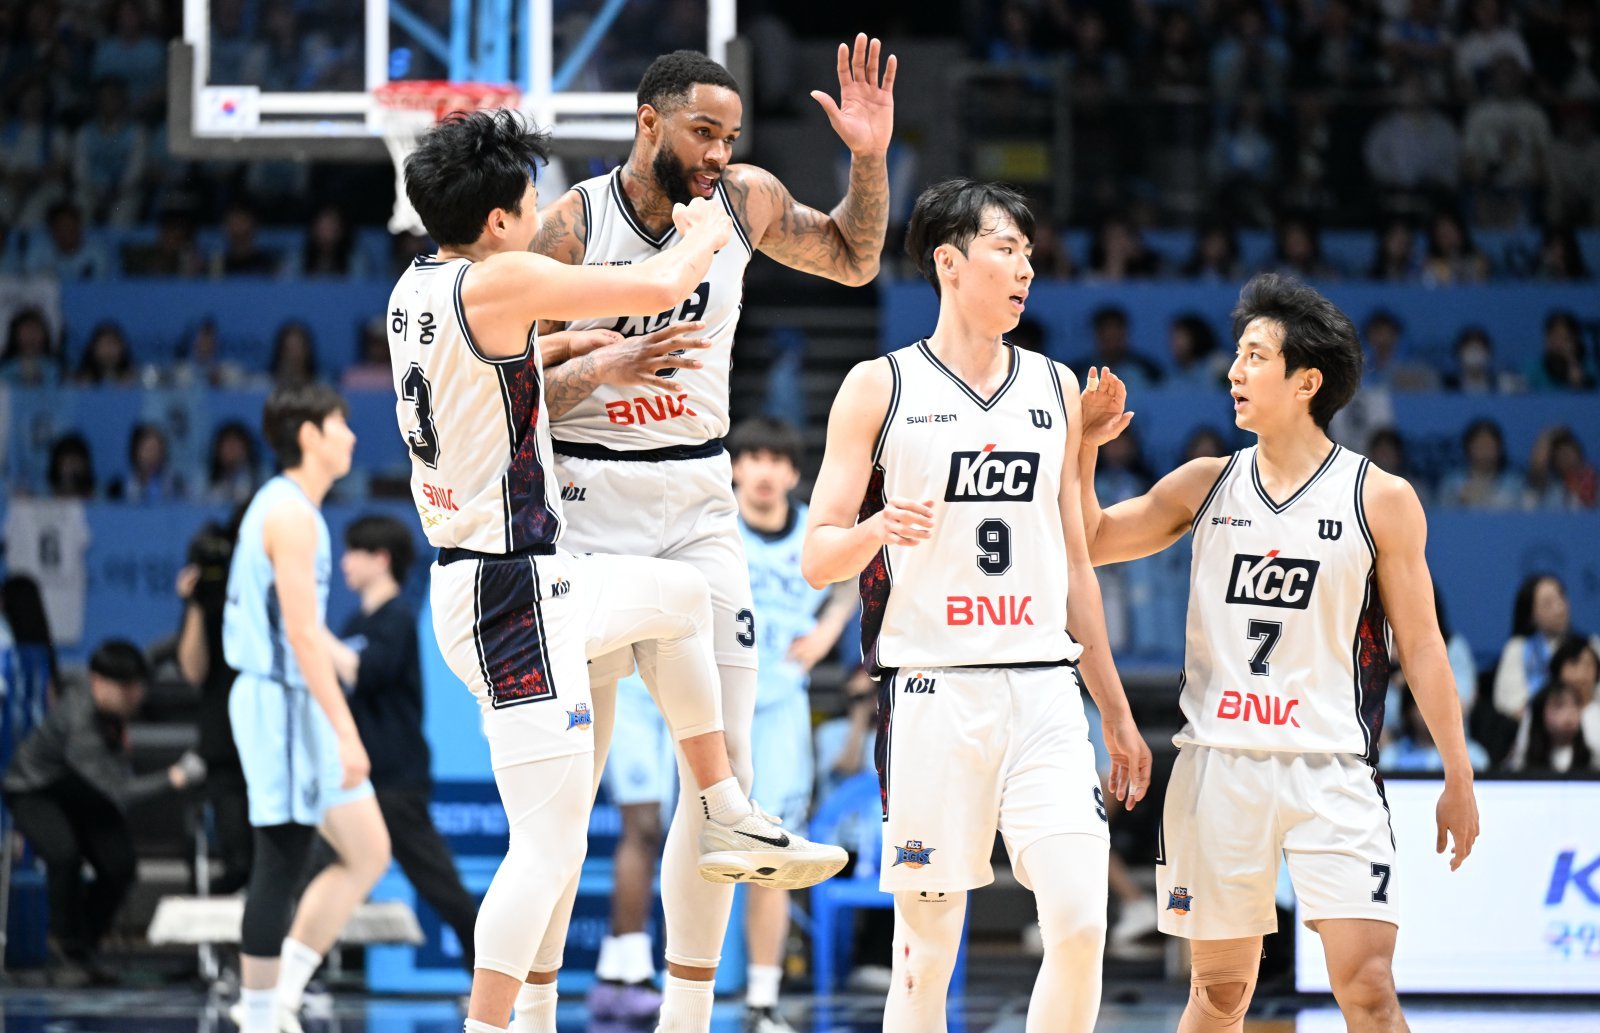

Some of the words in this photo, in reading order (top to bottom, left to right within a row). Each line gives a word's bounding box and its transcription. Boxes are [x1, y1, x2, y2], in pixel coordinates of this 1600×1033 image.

[401, 361, 441, 470] 3
[605, 394, 697, 426] BNK
[954, 443, 1032, 497] KCC
[975, 518, 1012, 576] 9
[1233, 549, 1310, 603] KCC
[735, 607, 755, 649] 3
[946, 595, 1034, 626] BNK
[1246, 618, 1283, 677] 7
[903, 673, 936, 695] KBL
[1216, 690, 1301, 729] BNK
[1370, 861, 1391, 905] 7
